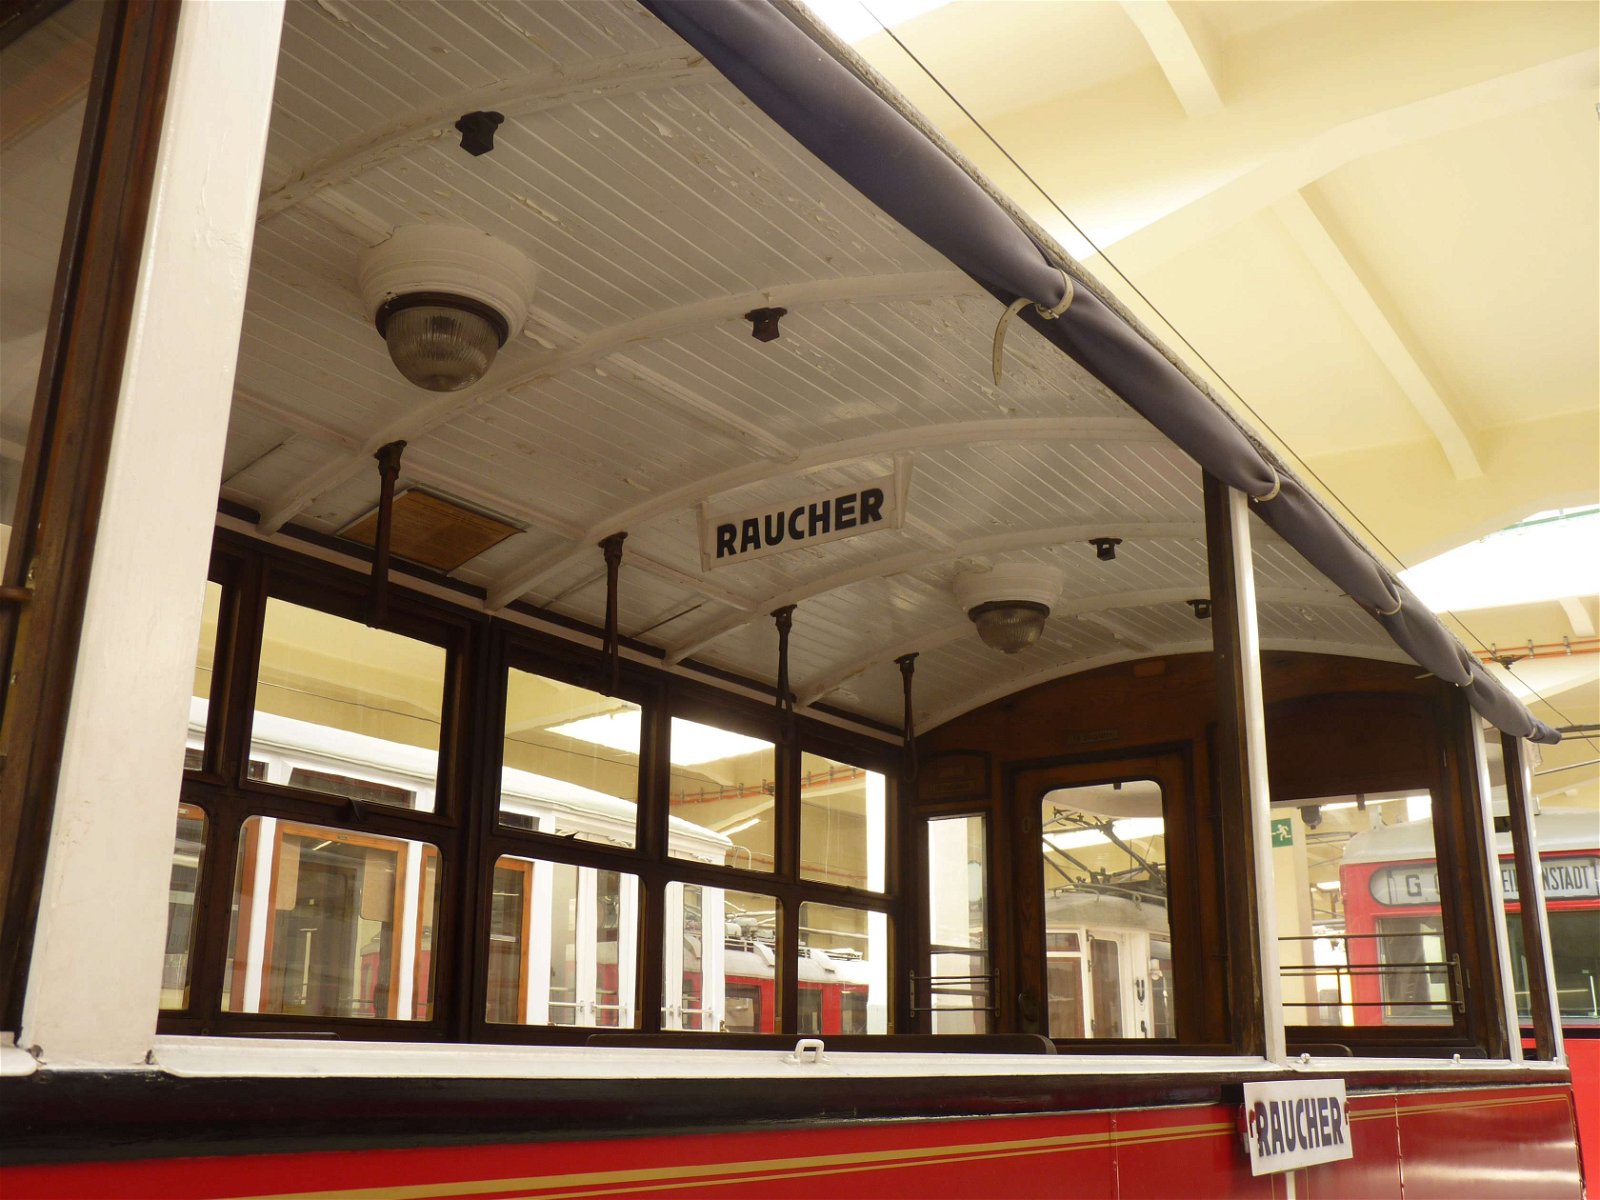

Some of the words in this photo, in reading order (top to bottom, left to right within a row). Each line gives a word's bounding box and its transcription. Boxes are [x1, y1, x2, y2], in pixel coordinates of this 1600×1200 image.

[716, 488, 884, 558] RAUCHER
[1405, 874, 1422, 897] G
[1502, 865, 1590, 892] EILNSTADT
[1254, 1097, 1344, 1157] RAUCHER
